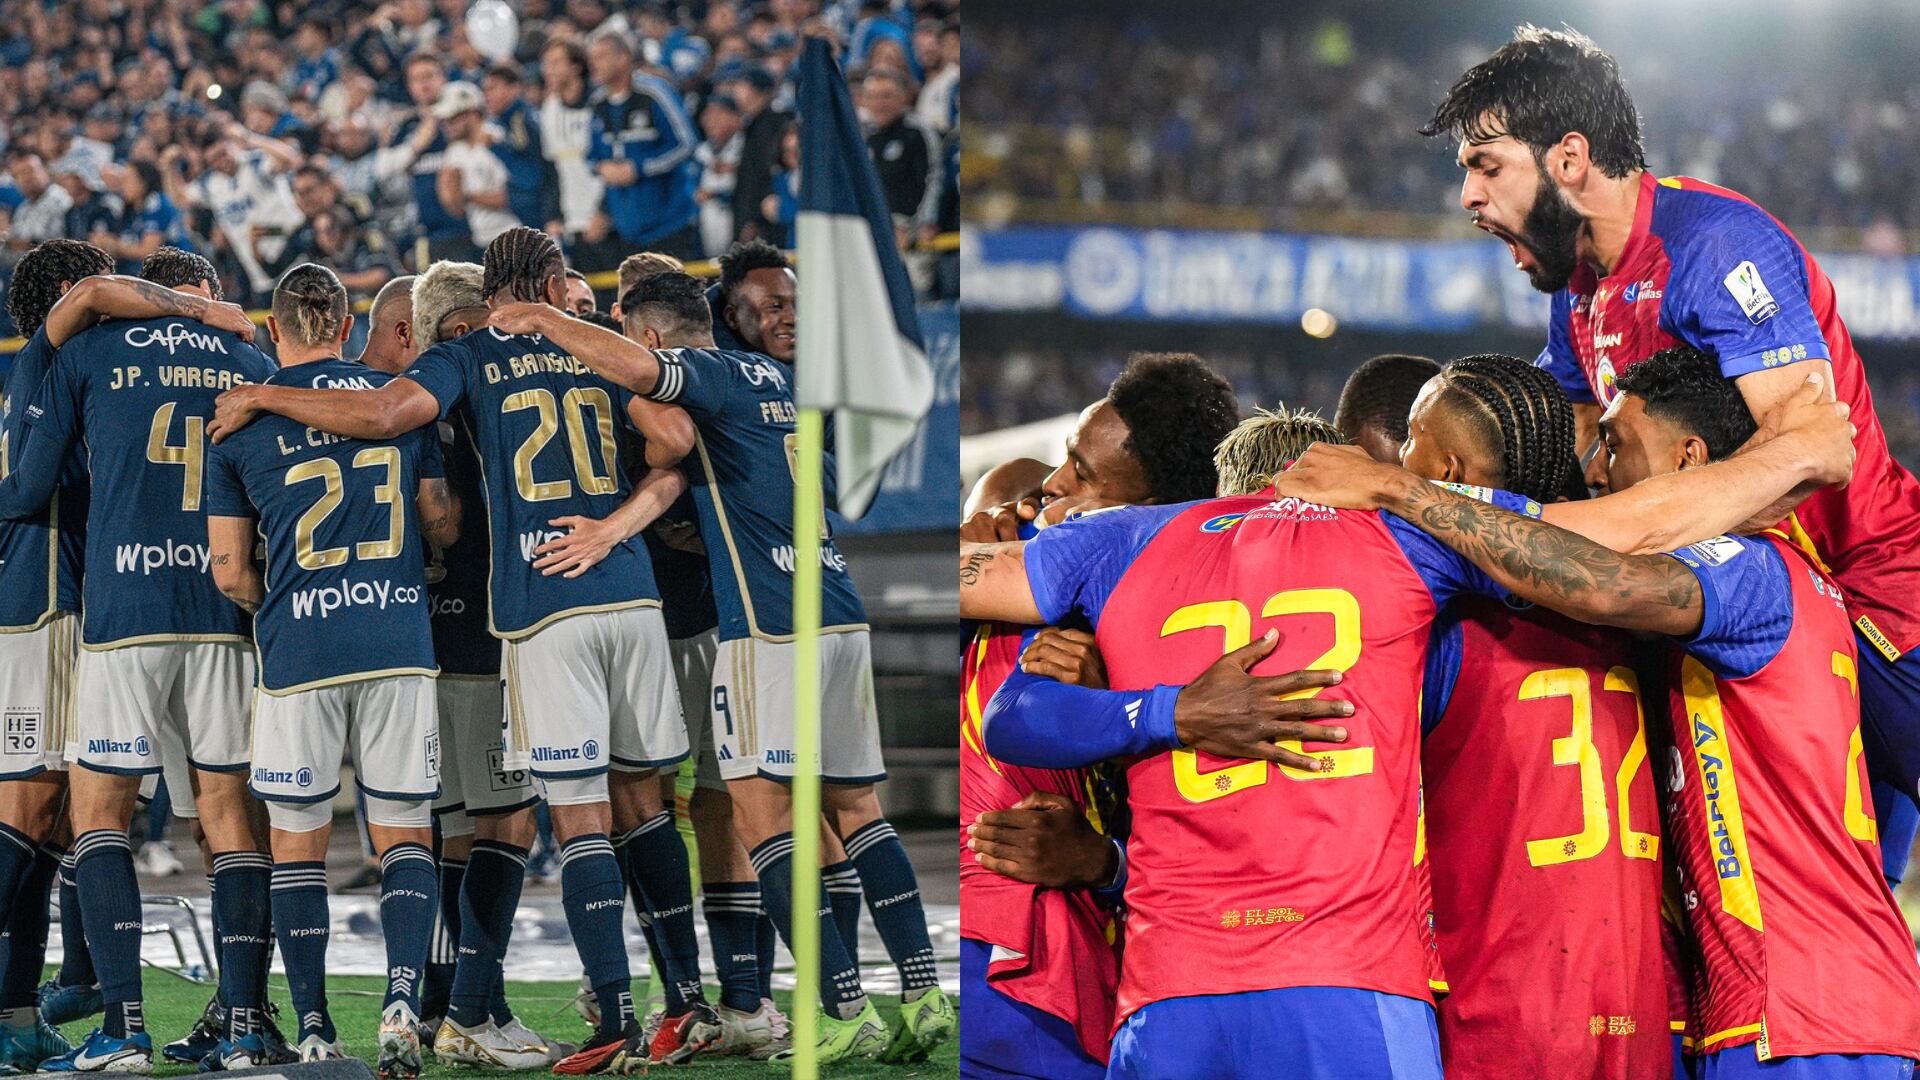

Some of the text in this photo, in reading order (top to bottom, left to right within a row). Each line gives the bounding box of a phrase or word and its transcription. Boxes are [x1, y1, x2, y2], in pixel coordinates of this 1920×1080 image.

[110, 366, 150, 390] JP.
[484, 352, 598, 385] D. BANGUE
[146, 402, 204, 512] 4
[501, 386, 619, 502] 20
[285, 446, 405, 570] 23
[714, 685, 734, 735] 9
[1160, 588, 1375, 804] 22
[88, 738, 132, 753] Allianz
[531, 747, 580, 761] Allianz
[1517, 666, 1660, 868] 32
[254, 768, 293, 783] Allianz
